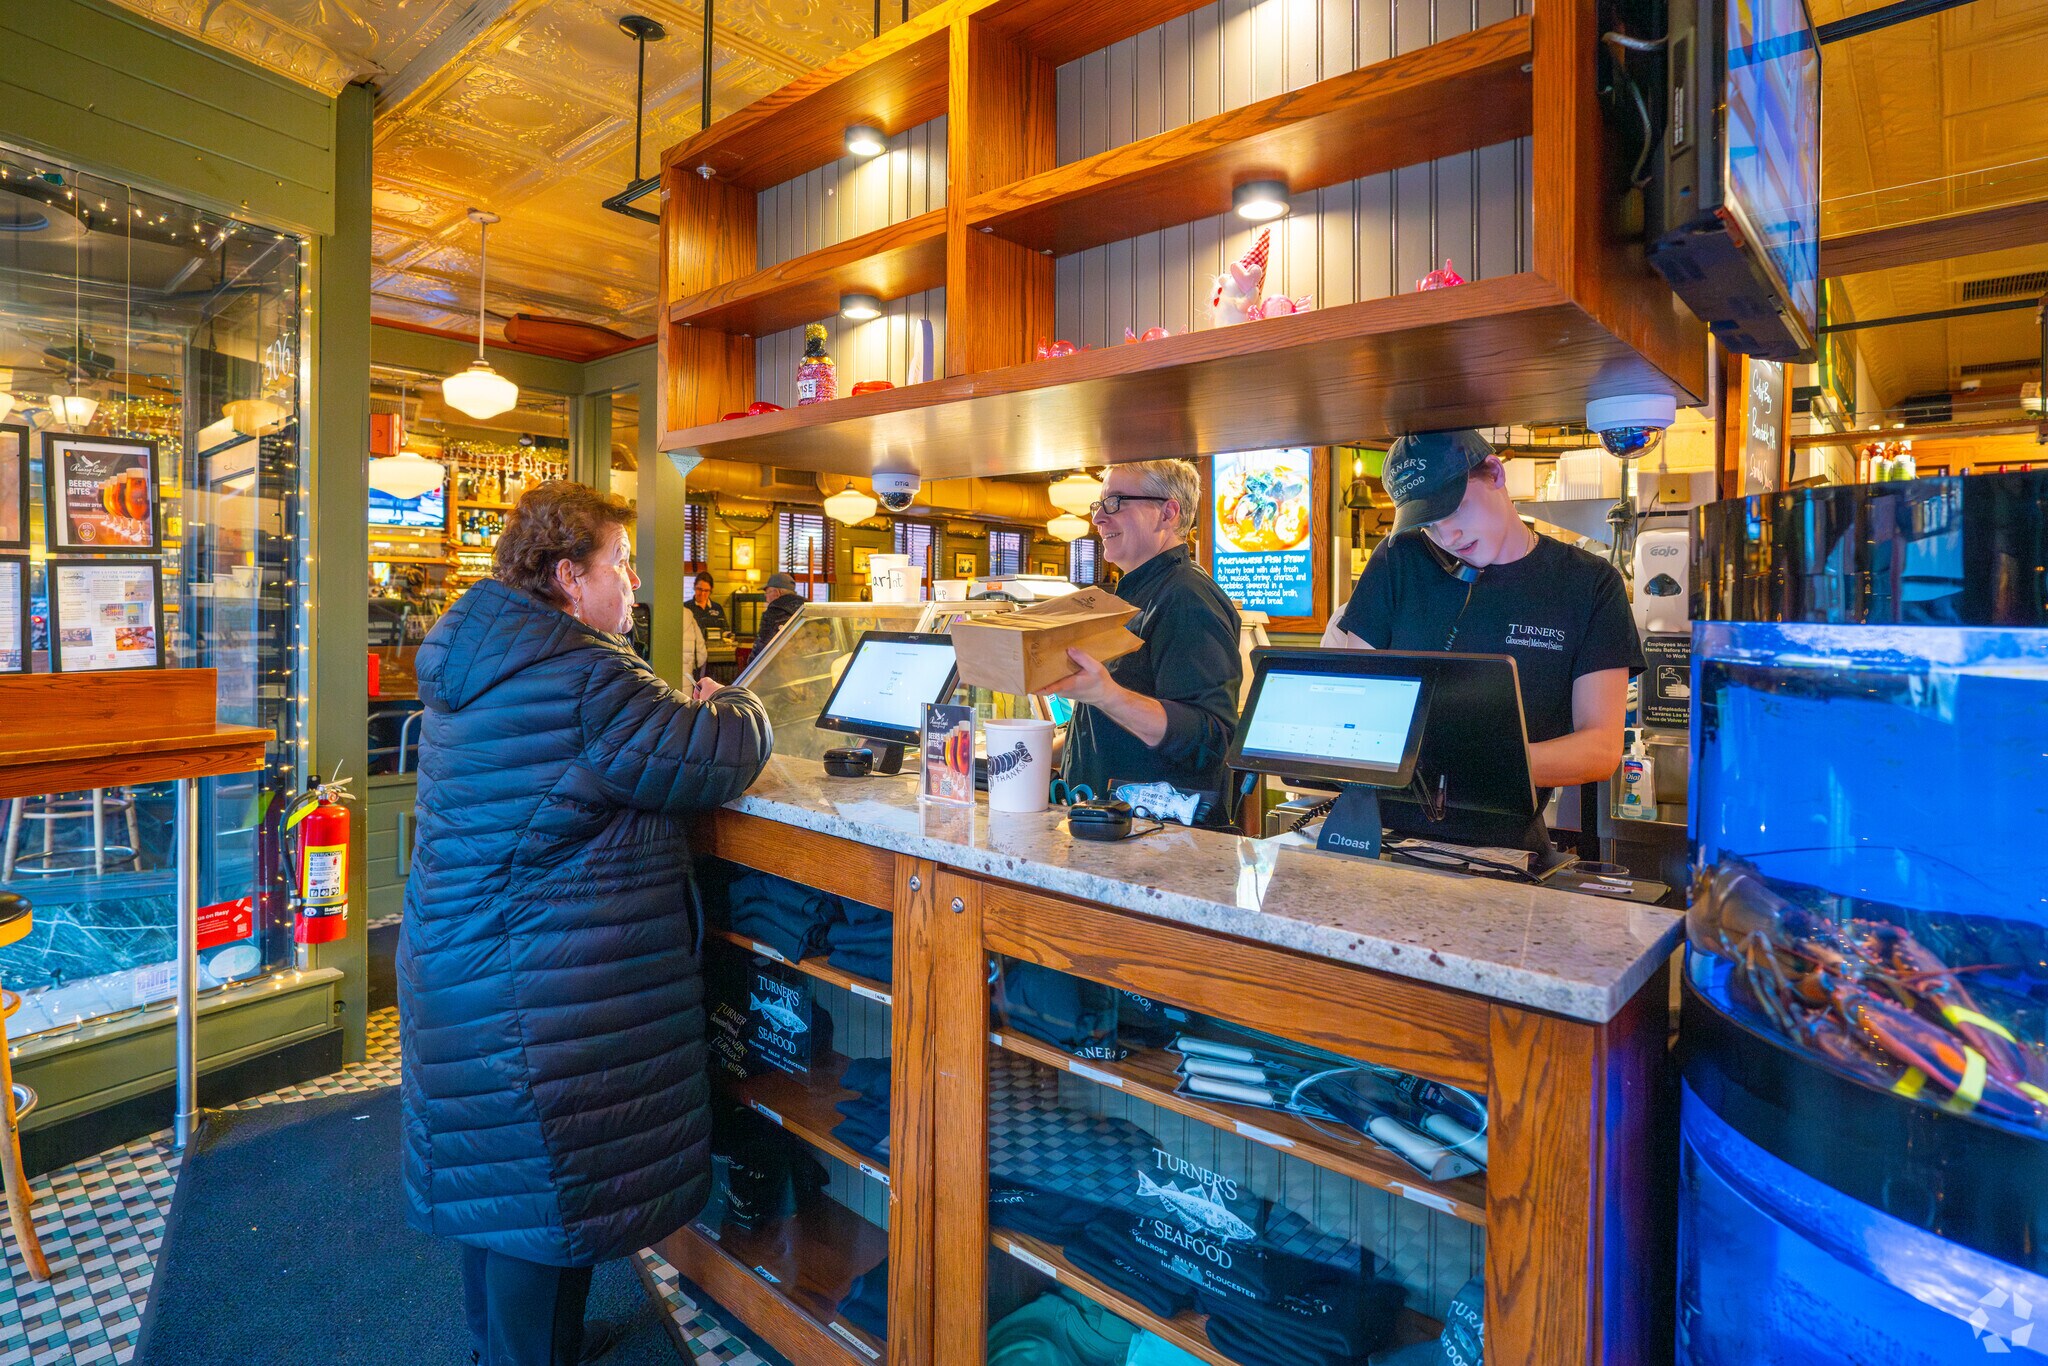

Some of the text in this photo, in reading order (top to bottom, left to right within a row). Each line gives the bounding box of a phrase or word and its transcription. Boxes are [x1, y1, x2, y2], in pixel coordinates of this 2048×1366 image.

[266, 332, 290, 386] 506
[68, 480, 92, 488] BEERS
[70, 488, 90, 496] BITES
[1394, 476, 1426, 499] SEAFOOD
[1650, 545, 1678, 557] GOJO
[1224, 566, 1241, 576] hearty
[1243, 566, 1254, 574] bowl
[1270, 566, 1280, 574] daily
[1252, 574, 1272, 583] shrimp,
[1282, 590, 1298, 598] broth,
[1250, 598, 1265, 607] grilled
[1508, 624, 1564, 642] TURNER'S
[928, 732, 940, 740] BEERS
[928, 740, 940, 748] BITES
[996, 760, 1028, 782] THANKS!
[1341, 836, 1370, 850] toast
[758, 974, 800, 1006] TURNER'S
[758, 1026, 796, 1054] SEAFOOD
[748, 1039, 765, 1051] MELROSE
[768, 1049, 780, 1058] SALEM
[783, 1057, 808, 1073] GLOUCESTER
[1152, 1148, 1238, 1200] TURNER'S
[1154, 1220, 1232, 1269] SEAFOOD
[1136, 1236, 1168, 1256] MELROSE
[1174, 1254, 1198, 1270] SALEM
[1206, 1270, 1256, 1299] GLOUCESTER
